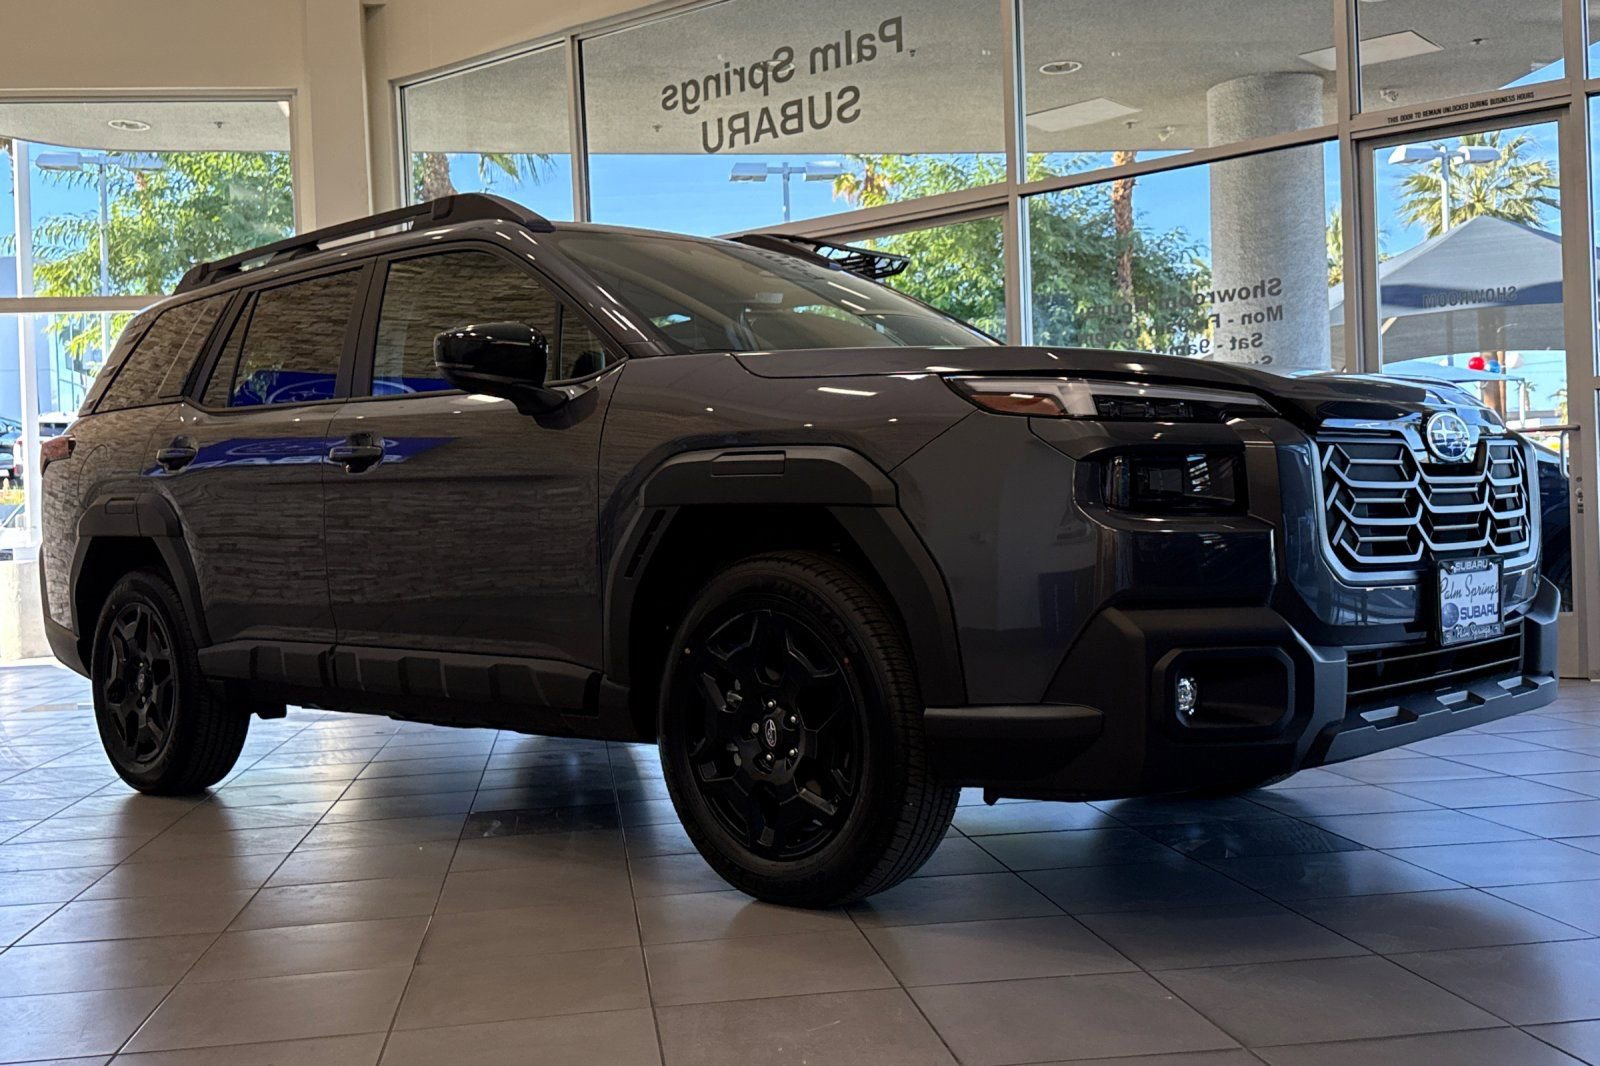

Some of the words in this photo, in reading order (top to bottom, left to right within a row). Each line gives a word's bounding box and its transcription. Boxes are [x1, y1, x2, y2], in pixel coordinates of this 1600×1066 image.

[1387, 115, 1399, 123] THIS
[1400, 113, 1413, 122] DOOR
[1414, 111, 1422, 119] TO
[1422, 108, 1441, 117] REMAIN
[1443, 103, 1469, 113] UNLOCKED
[1469, 99, 1489, 109] DURING
[1490, 95, 1515, 105] BUSINESS
[1516, 92, 1534, 101] HOURS
[1455, 560, 1489, 571] SUBARU
[1440, 577, 1462, 600] Palm
